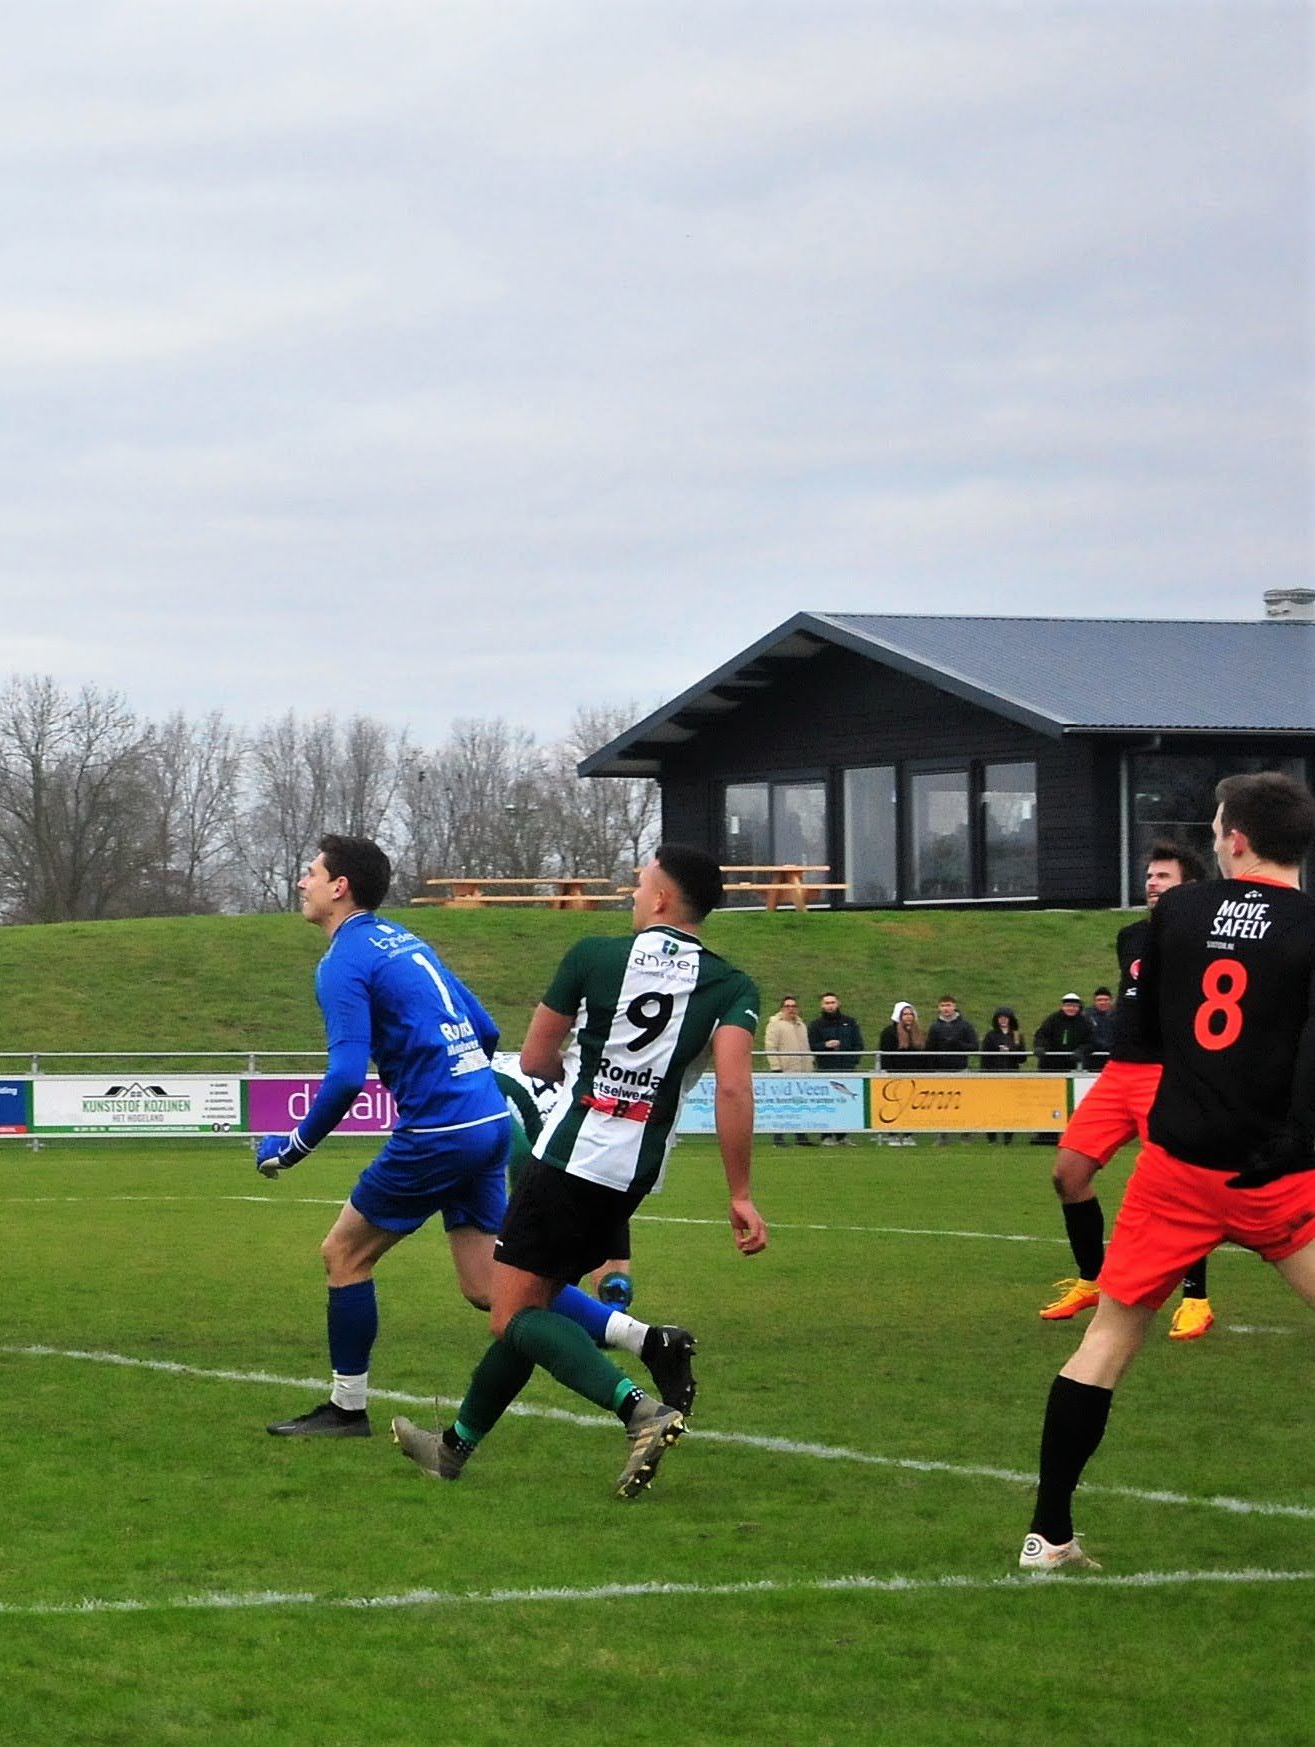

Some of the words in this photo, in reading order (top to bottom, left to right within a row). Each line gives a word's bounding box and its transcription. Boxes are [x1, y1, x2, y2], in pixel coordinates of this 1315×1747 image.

[1217, 900, 1270, 920] MOVE
[1210, 917, 1272, 939] SAFELY
[411, 952, 459, 1019] 1
[1194, 958, 1248, 1050] 8
[626, 992, 674, 1052] 9
[796, 1081, 830, 1096] Veen
[82, 1099, 141, 1113] KUNSTSTOF
[144, 1099, 191, 1113] KOZIJNEN
[127, 1113, 165, 1122] HOGELAND
